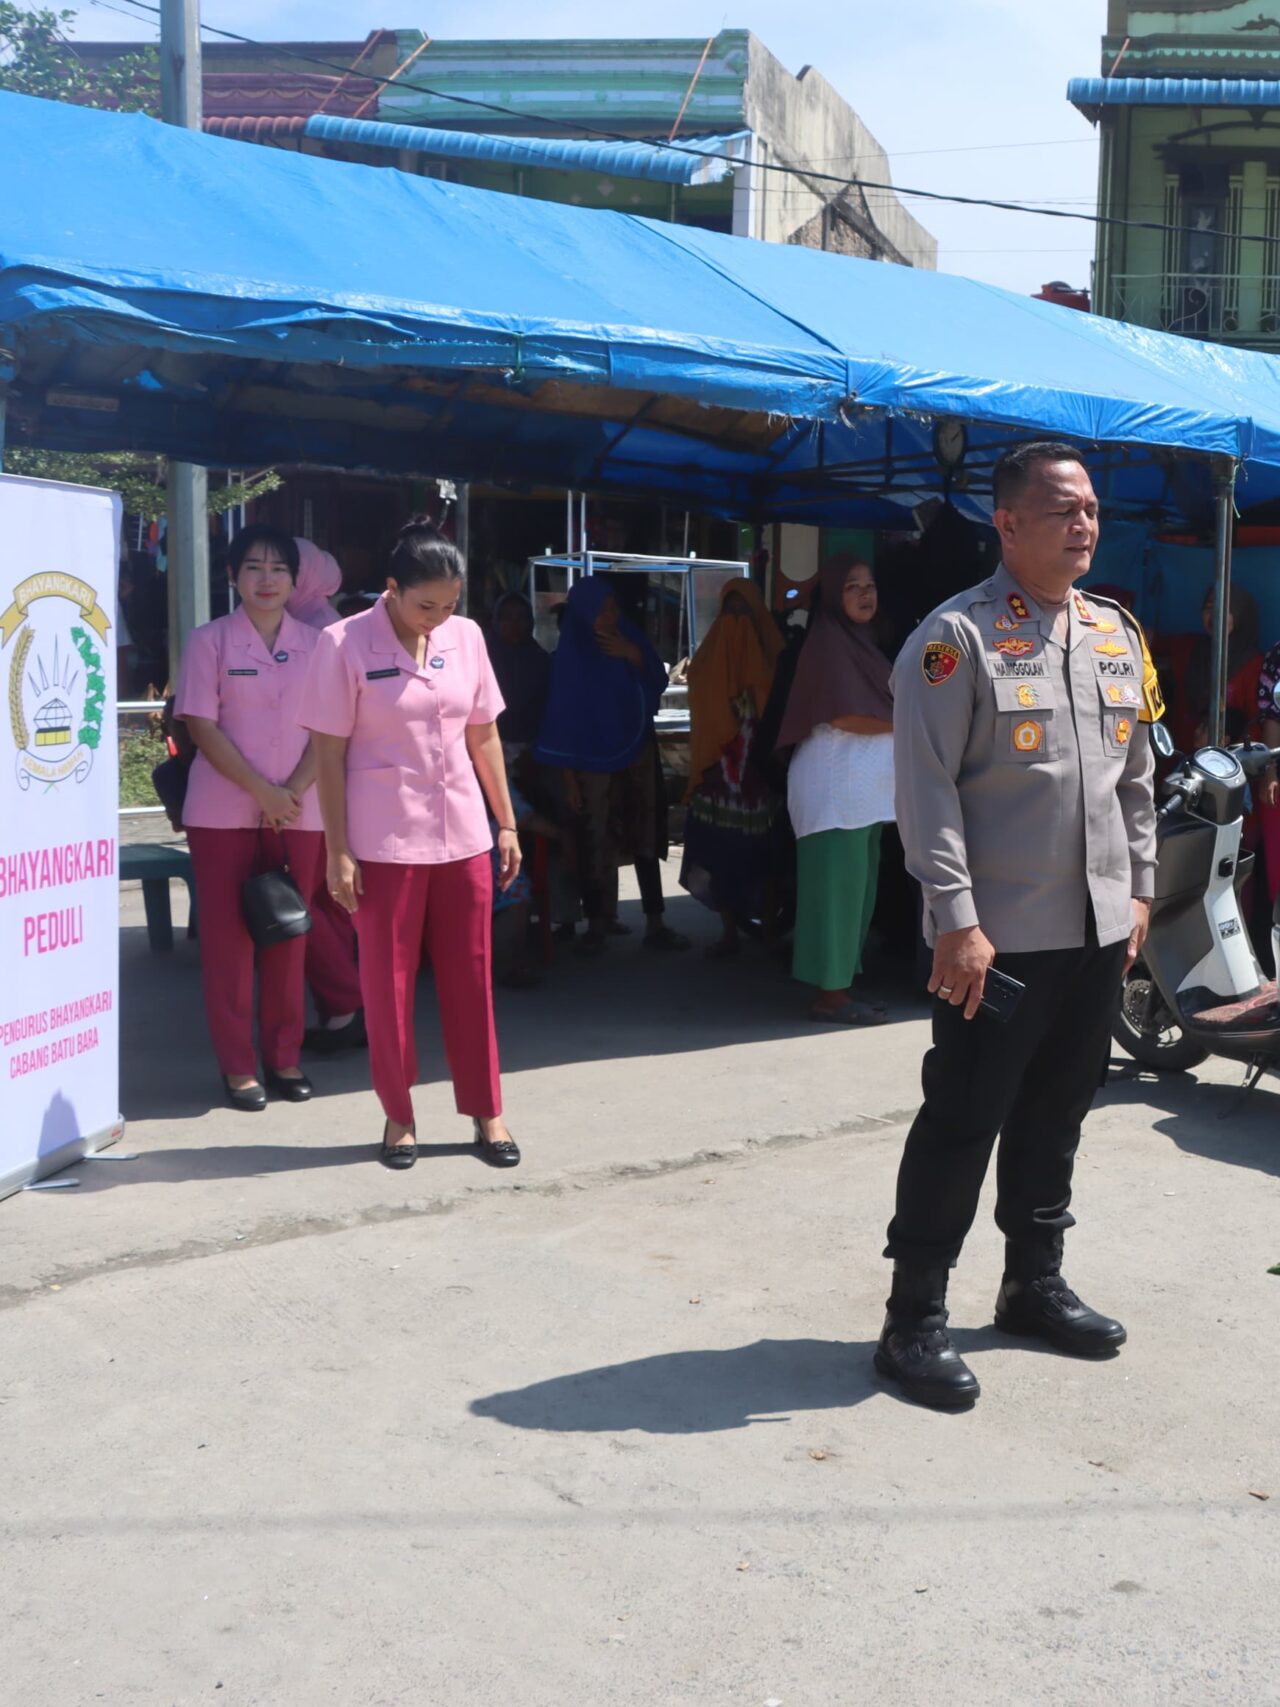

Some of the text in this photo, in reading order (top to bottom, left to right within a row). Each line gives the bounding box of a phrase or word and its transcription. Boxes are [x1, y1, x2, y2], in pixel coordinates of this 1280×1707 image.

[1098, 661, 1135, 677] POLRI
[24, 903, 83, 957] PEDULI
[50, 989, 113, 1031] BHAYANGKARI
[10, 1026, 100, 1080] CABANG BATU BARA
